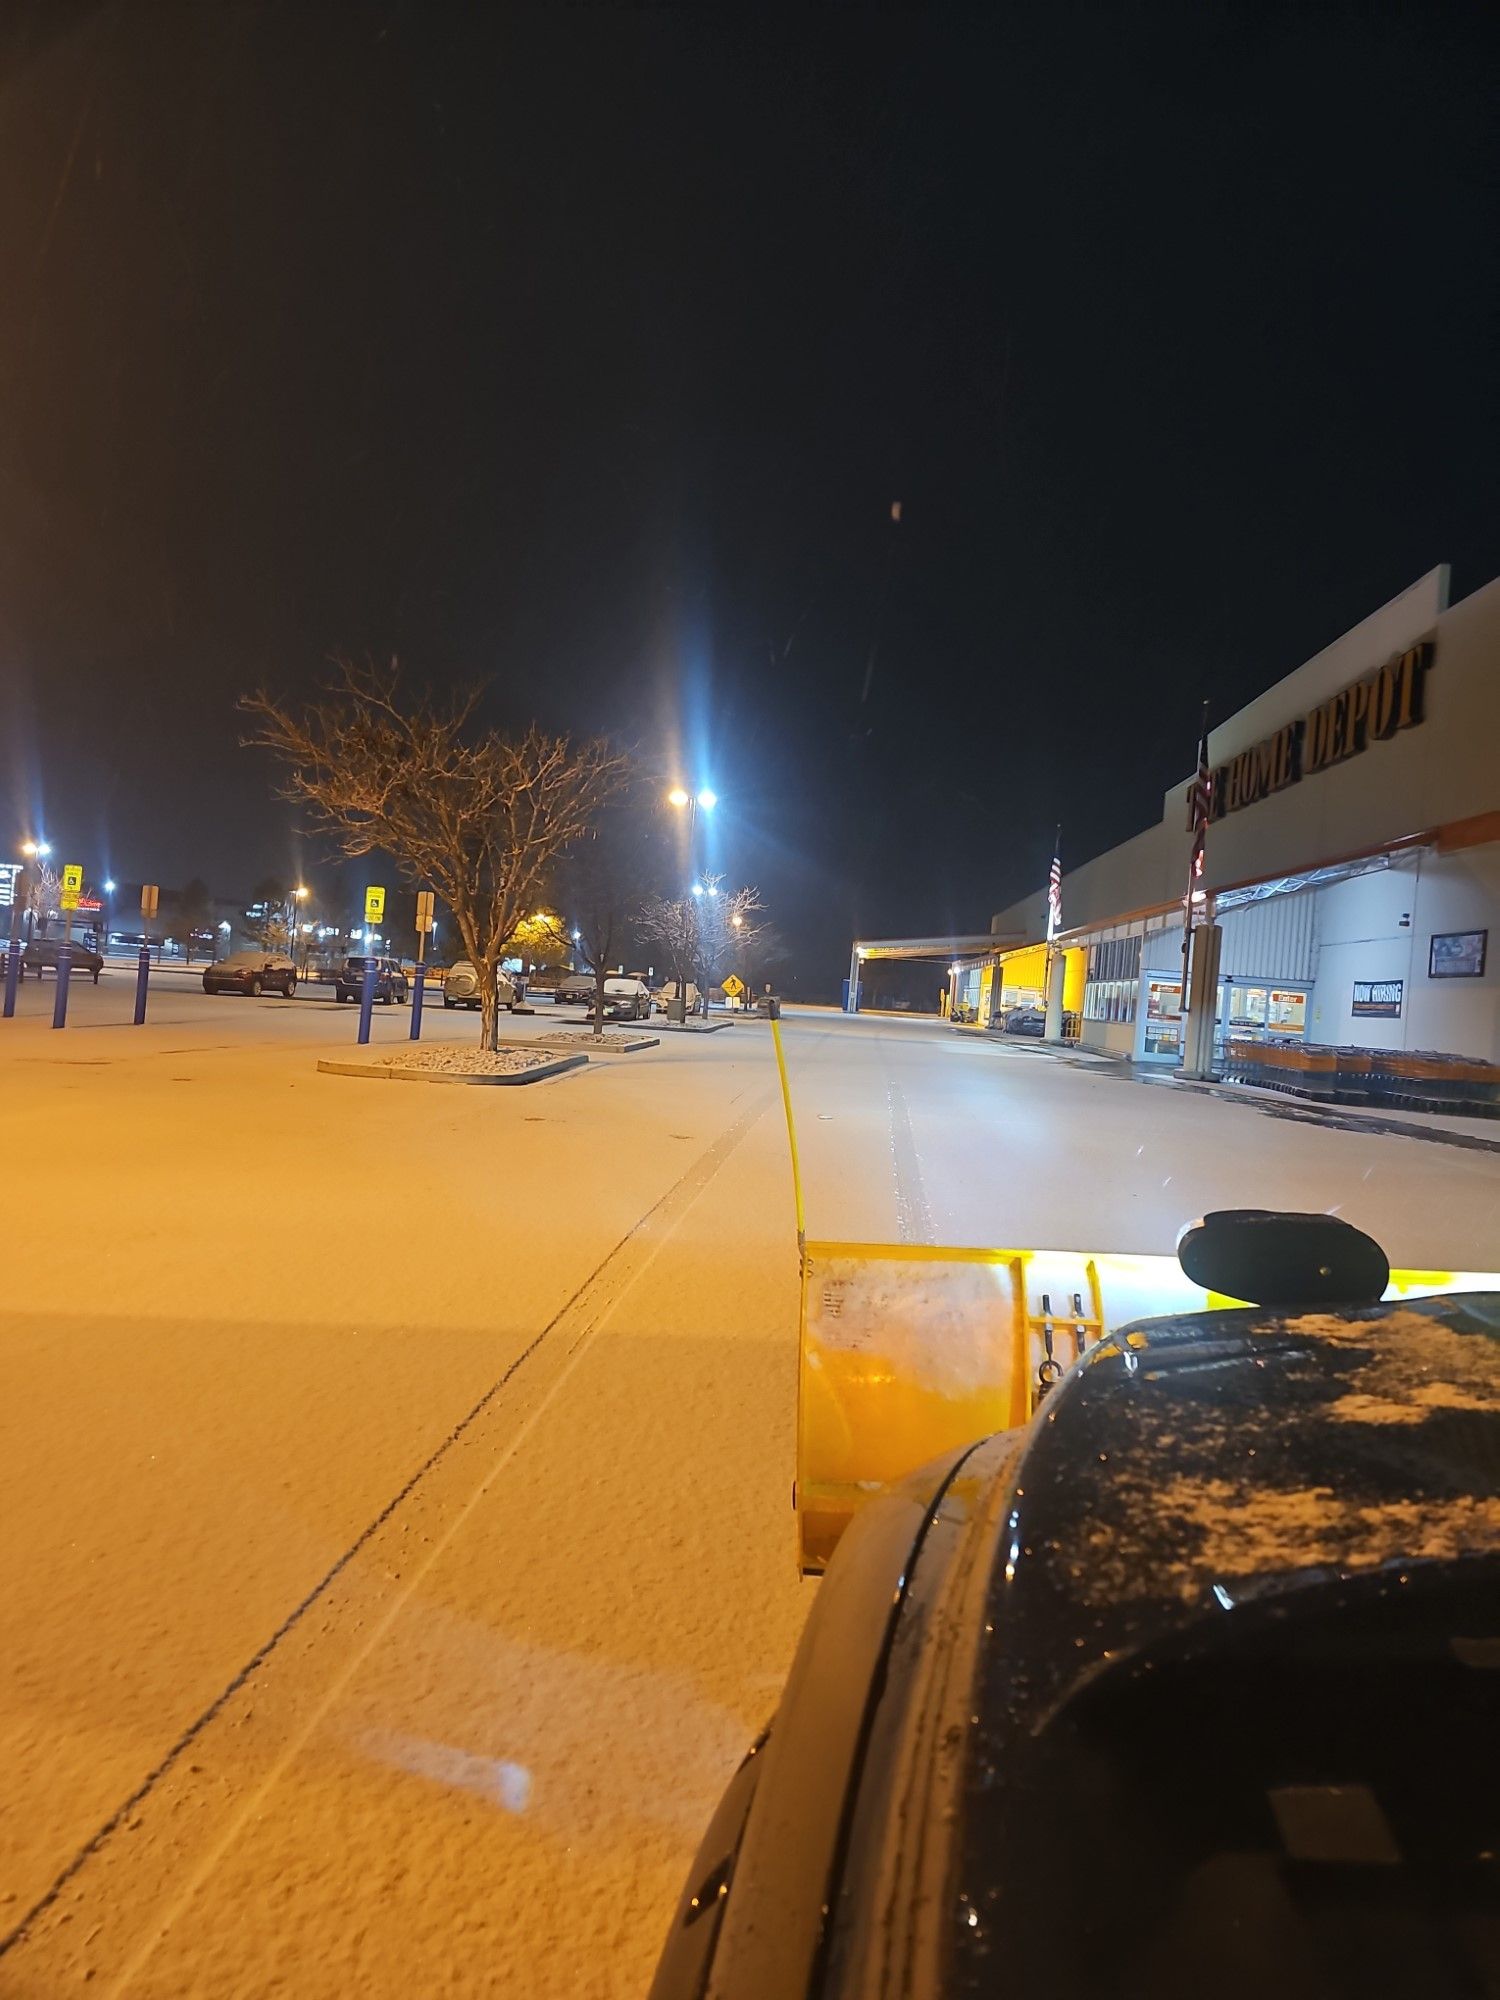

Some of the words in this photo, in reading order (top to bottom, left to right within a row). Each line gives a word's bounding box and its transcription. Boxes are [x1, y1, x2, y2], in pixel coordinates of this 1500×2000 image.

[1225, 722, 1302, 812] HOME
[1304, 644, 1435, 774] DEPOT
[1354, 984, 1372, 1002] NOW
[1372, 984, 1401, 1002] HIRING
